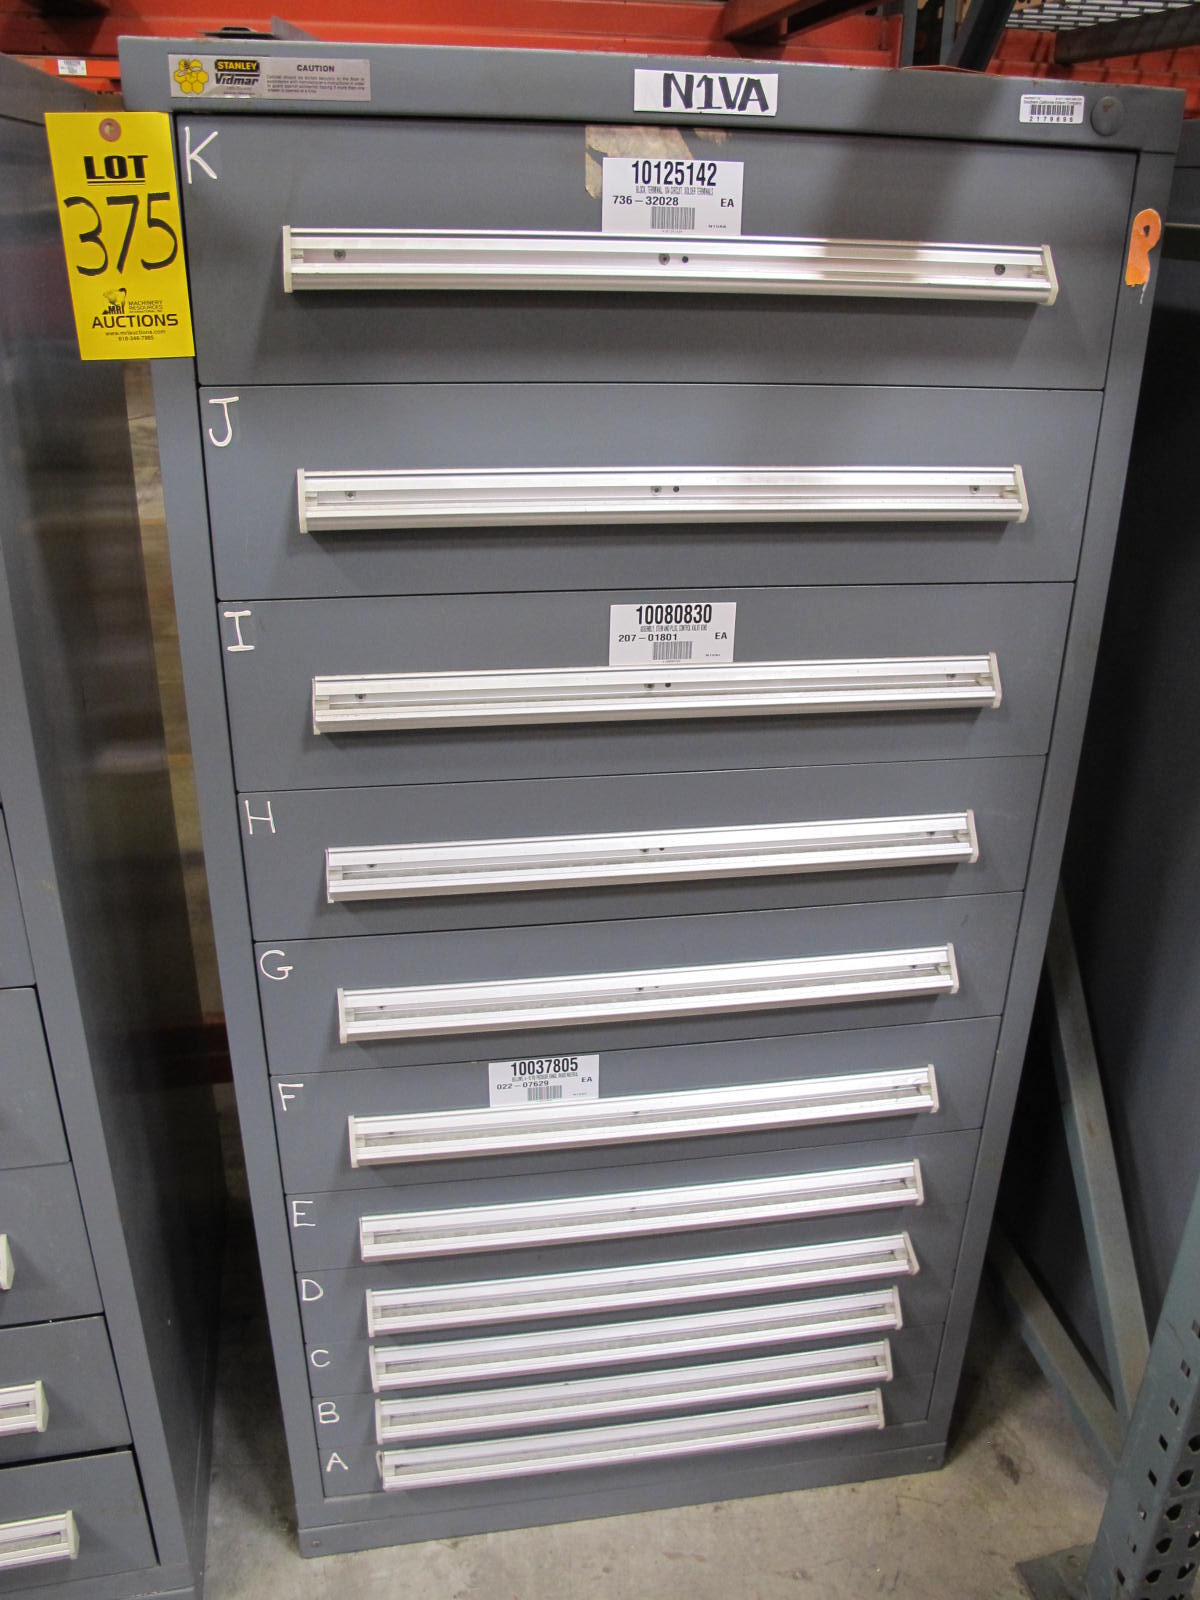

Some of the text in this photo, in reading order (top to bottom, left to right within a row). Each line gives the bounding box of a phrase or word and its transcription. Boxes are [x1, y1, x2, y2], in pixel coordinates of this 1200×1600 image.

[217, 61, 257, 71] STANLEY
[296, 64, 335, 73] CAUTION
[215, 73, 259, 86] Vidmar
[185, 126, 218, 184] K
[83, 155, 148, 179] LOT
[632, 160, 717, 187] 10125142
[720, 198, 734, 208] EA
[63, 192, 178, 276] 375
[92, 313, 178, 329] AUCTIONS
[208, 396, 239, 448] J
[636, 604, 712, 625] 10080830
[224, 610, 255, 652] I
[715, 632, 728, 640] EA
[245, 800, 276, 835] H
[260, 949, 293, 980] G
[511, 1057, 578, 1076] 10037805
[278, 1083, 304, 1111] F
[292, 1200, 316, 1227] E
[302, 1279, 324, 1302] D
[310, 1349, 331, 1368] C
[317, 1401, 340, 1424] B
[326, 1452, 349, 1472] A
